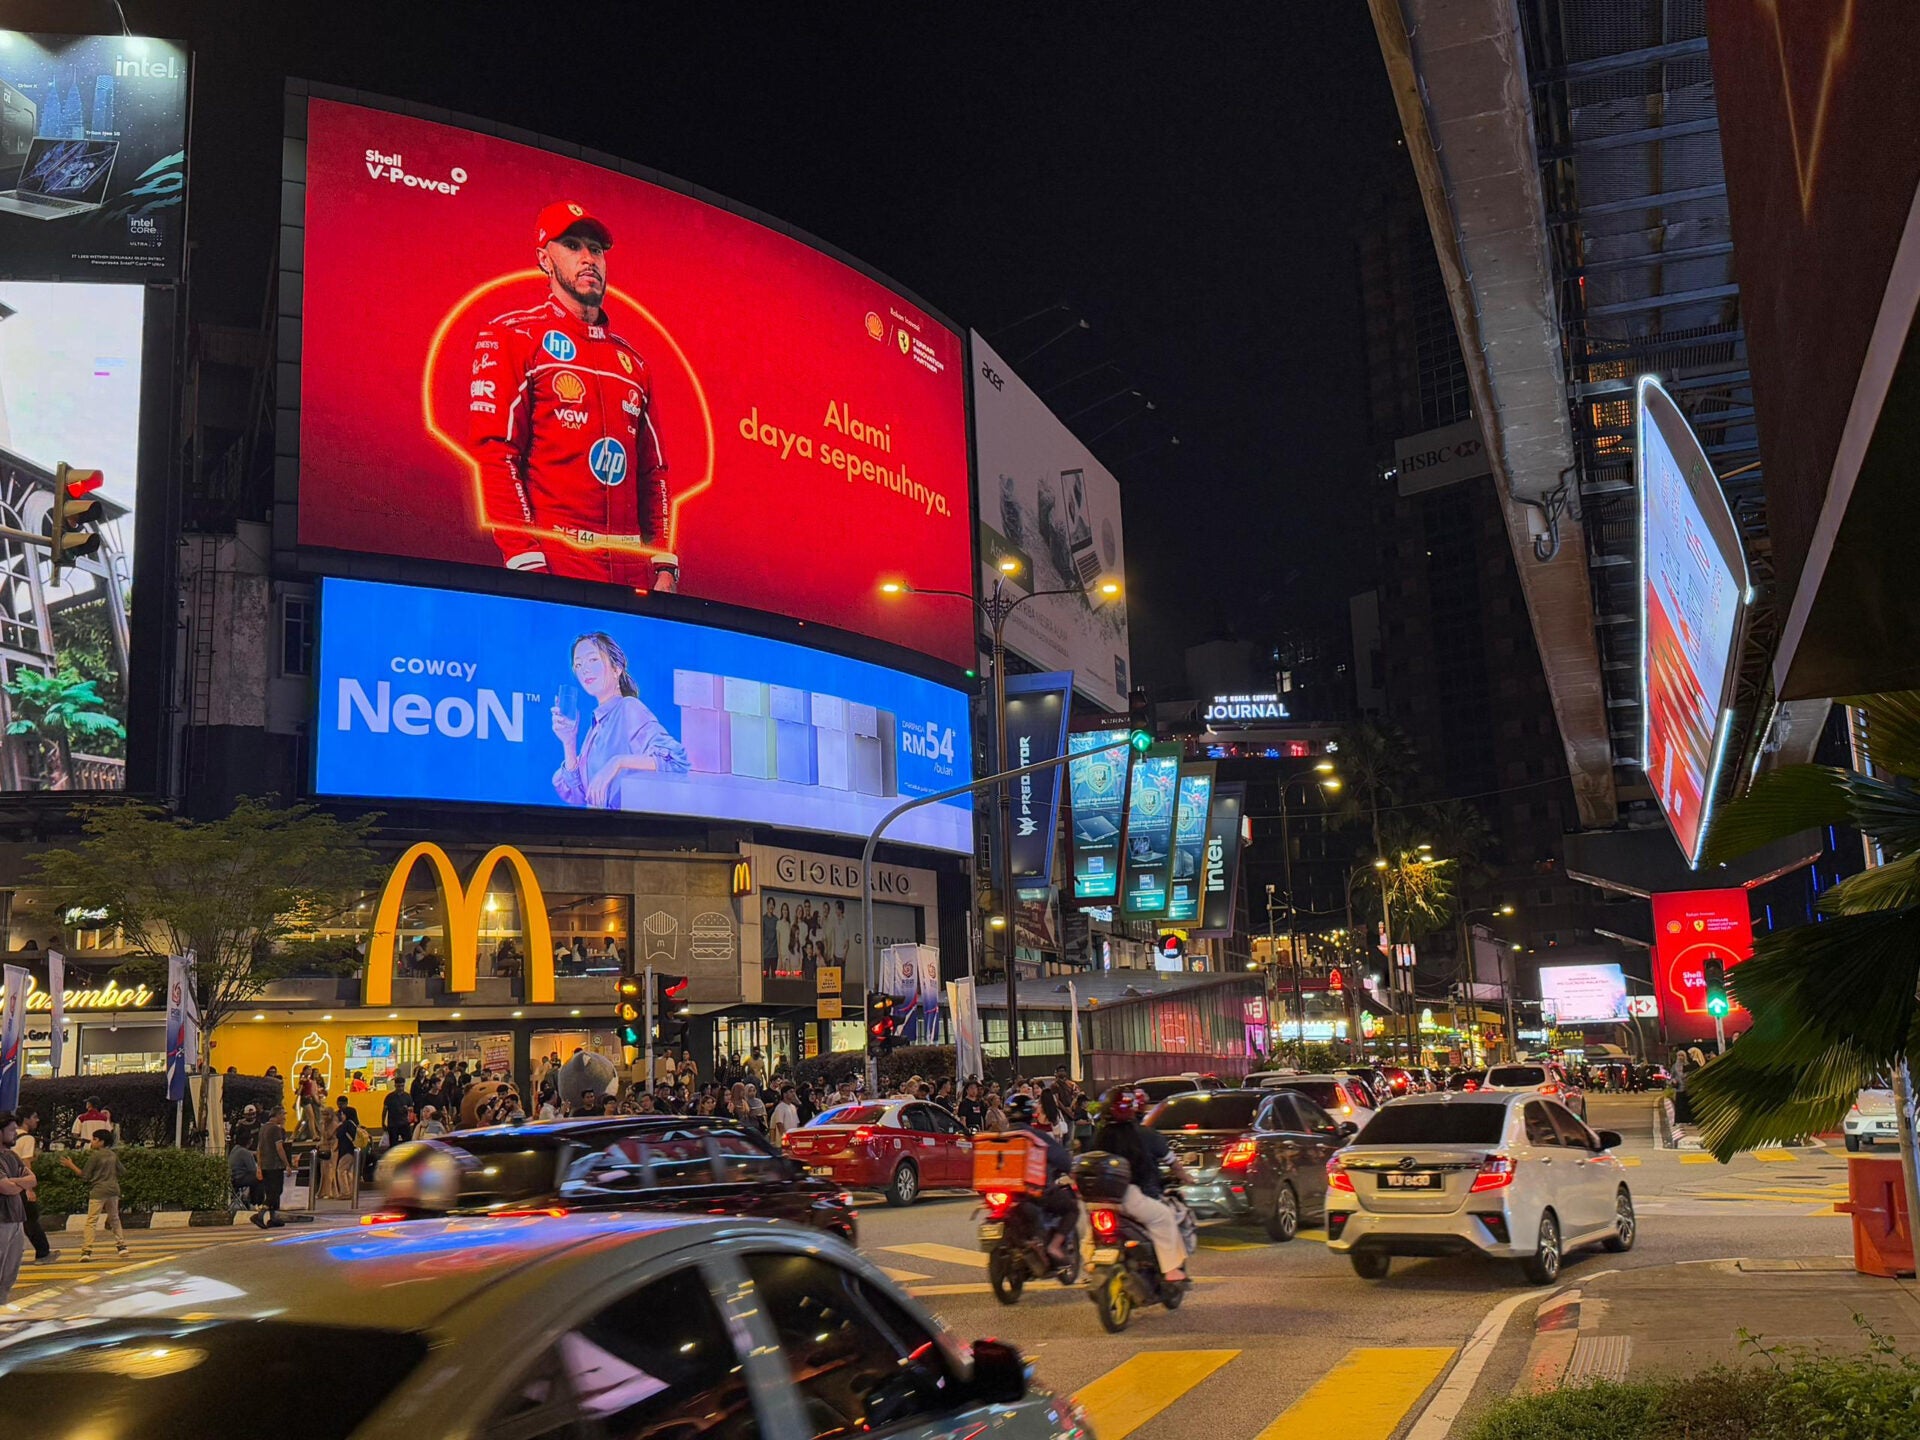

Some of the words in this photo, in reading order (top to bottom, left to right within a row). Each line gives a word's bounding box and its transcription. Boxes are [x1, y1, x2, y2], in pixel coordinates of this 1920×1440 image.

[365, 149, 402, 167] Shell
[365, 162, 460, 195] V-Power
[130, 217, 154, 227] intel
[550, 333, 570, 360] hp
[981, 361, 1005, 393] acer
[554, 408, 589, 425] VGW
[823, 400, 890, 453] Alami
[595, 439, 625, 484] hp
[739, 407, 812, 460] daya
[820, 443, 951, 517] sepenuhnya.
[1401, 447, 1451, 474] HSBC
[580, 531, 595, 543] 44
[390, 656, 477, 683] coway
[338, 677, 524, 742] NeoN
[1203, 703, 1291, 720] JOURNAL
[1682, 970, 1702, 980] Shell
